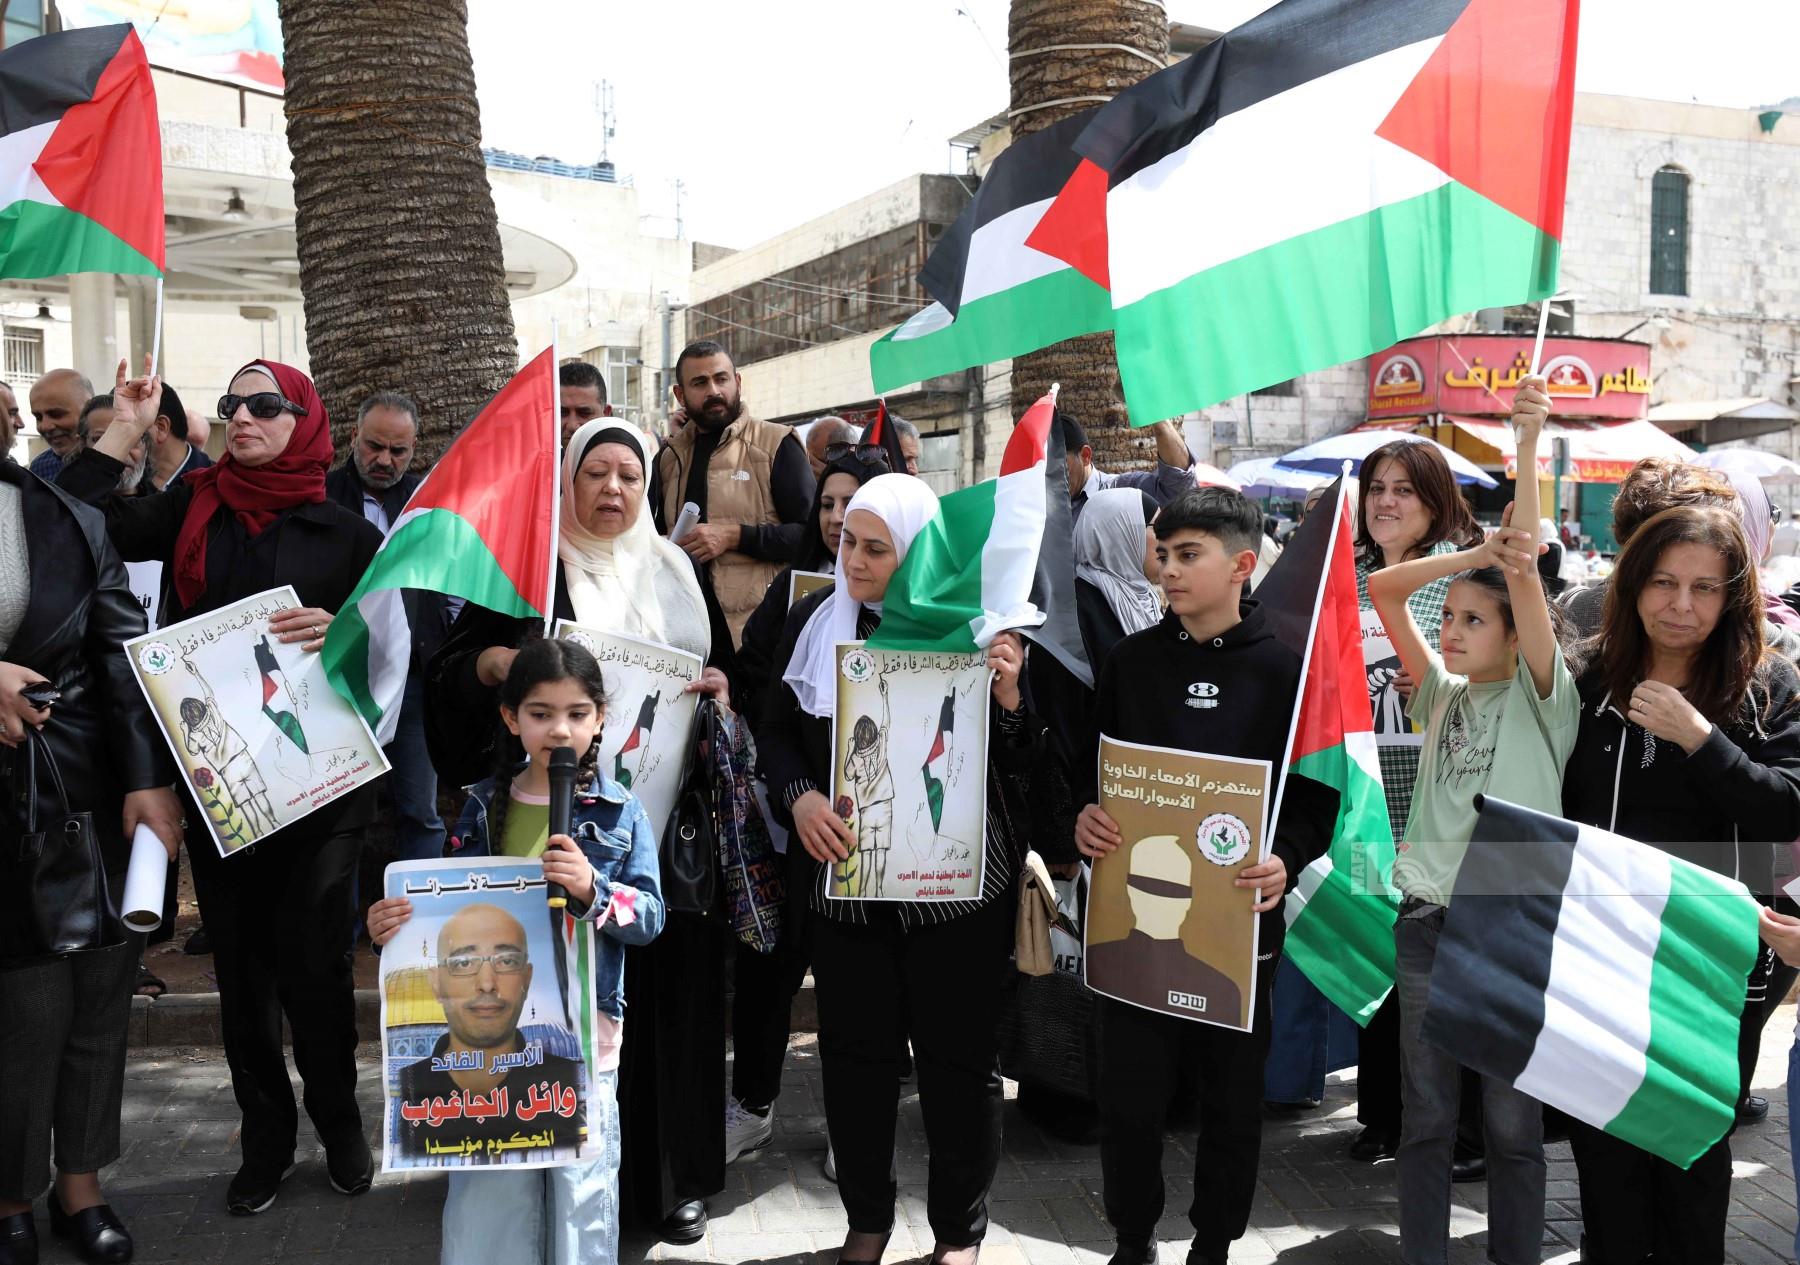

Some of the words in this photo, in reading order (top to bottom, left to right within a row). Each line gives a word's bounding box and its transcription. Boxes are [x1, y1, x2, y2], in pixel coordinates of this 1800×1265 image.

[1445, 351, 1531, 396] شرف
[1599, 366, 1654, 396] مطاعم
[255, 600, 289, 620] فلسطين
[229, 611, 254, 631] قضية
[201, 623, 231, 645] الشرفاء
[176, 634, 200, 658] فقط
[597, 641, 617, 661] فقط
[617, 648, 644, 667] الشرفاء
[643, 655, 665, 673] قضية
[879, 653, 901, 675] فقط
[903, 653, 934, 674] الشرفاء
[936, 655, 959, 674] قضية
[960, 651, 987, 672] فلسطين
[665, 659, 693, 681] فلسطين
[1103, 760, 1147, 780] الخاوية
[1103, 780, 1144, 800] العالية
[1201, 778, 1262, 796] ستهزم
[405, 873, 479, 896] لأسرانا
[481, 876, 548, 891] رية
[1170, 993, 1204, 1009] שבס
[431, 1050, 485, 1072] القائد
[489, 1044, 544, 1074] الأسير
[401, 1086, 509, 1127] الجاغوب
[515, 1081, 577, 1121] وائل
[425, 1135, 484, 1157] مؤبدا
[487, 1129, 555, 1156] المحكوم
